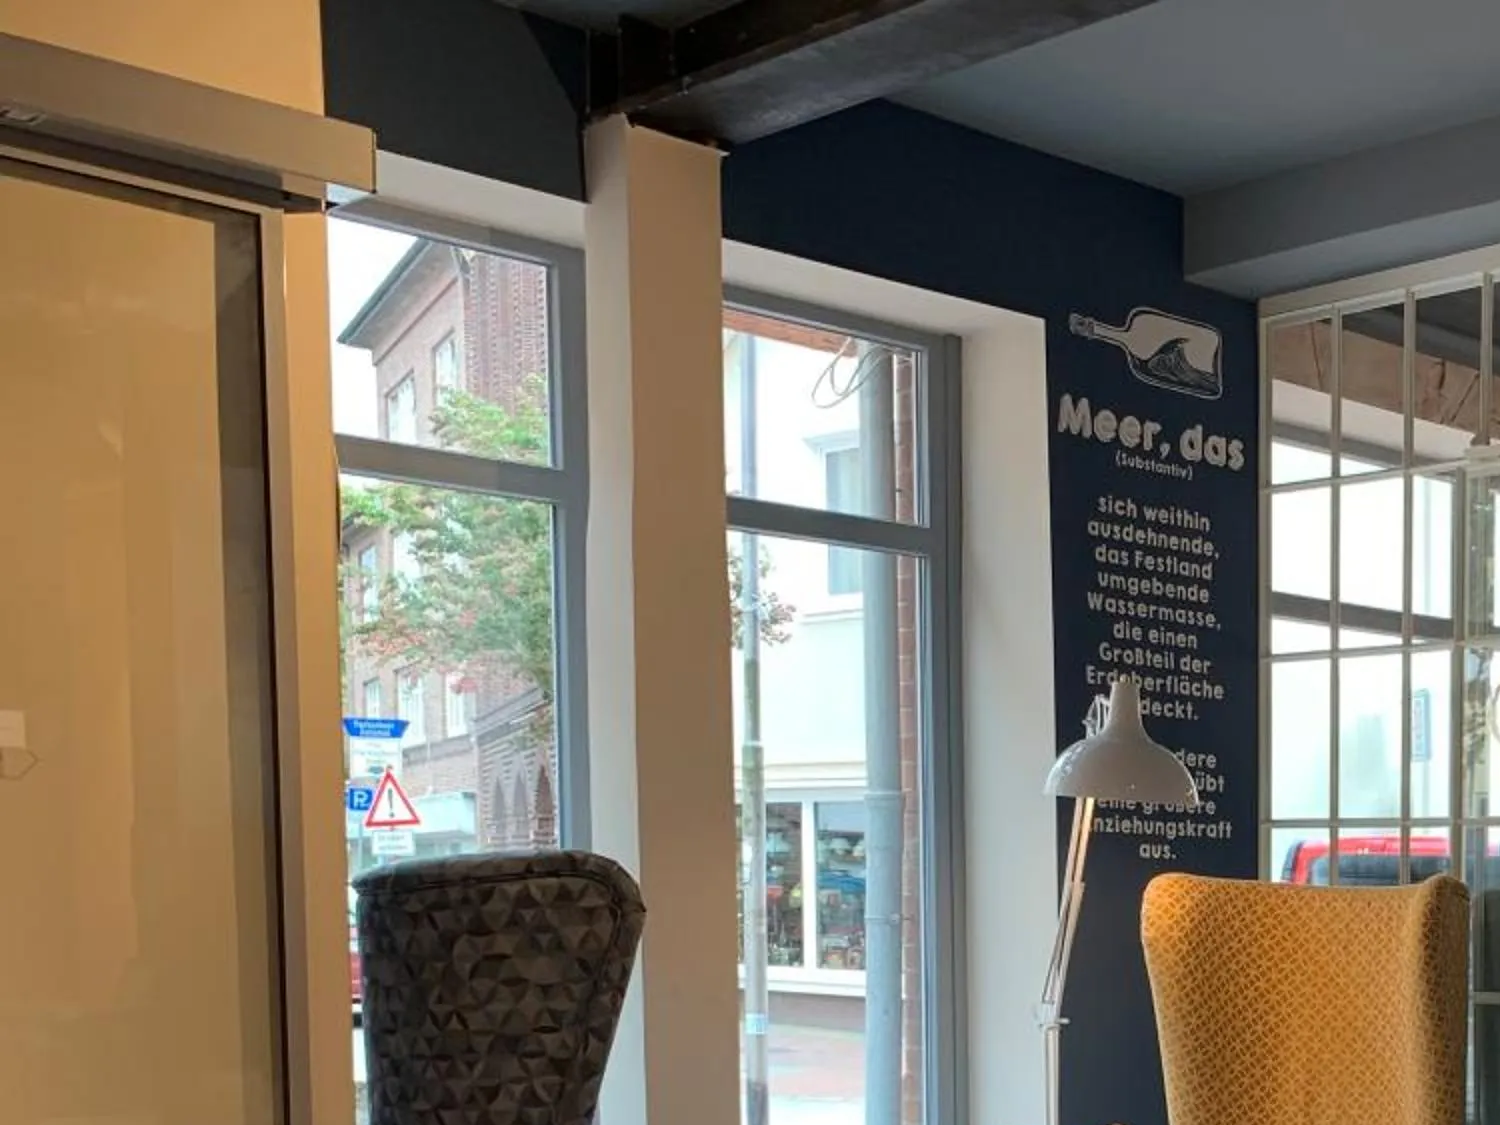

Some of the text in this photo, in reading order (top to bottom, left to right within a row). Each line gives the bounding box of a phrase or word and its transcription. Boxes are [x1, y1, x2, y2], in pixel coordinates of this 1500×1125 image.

[1057, 393, 1245, 471] Meer, das
[1115, 450, 1193, 481] (Substantiv)
[1097, 495, 1211, 532] sich weithin
[1087, 520, 1220, 559] ausdehnende,
[1095, 543, 1213, 580] das Festland
[1097, 571, 1210, 604] umgebende
[1087, 591, 1221, 631] Wassermasse,
[1113, 621, 1198, 649] die einen
[1099, 641, 1212, 675] Großteil der
[1140, 698, 1200, 720] deckt.
[1176, 748, 1217, 769] dere
[1195, 770, 1225, 793] übt
[1090, 815, 1233, 839] nziehungskraft
[1139, 842, 1177, 859] aus.
